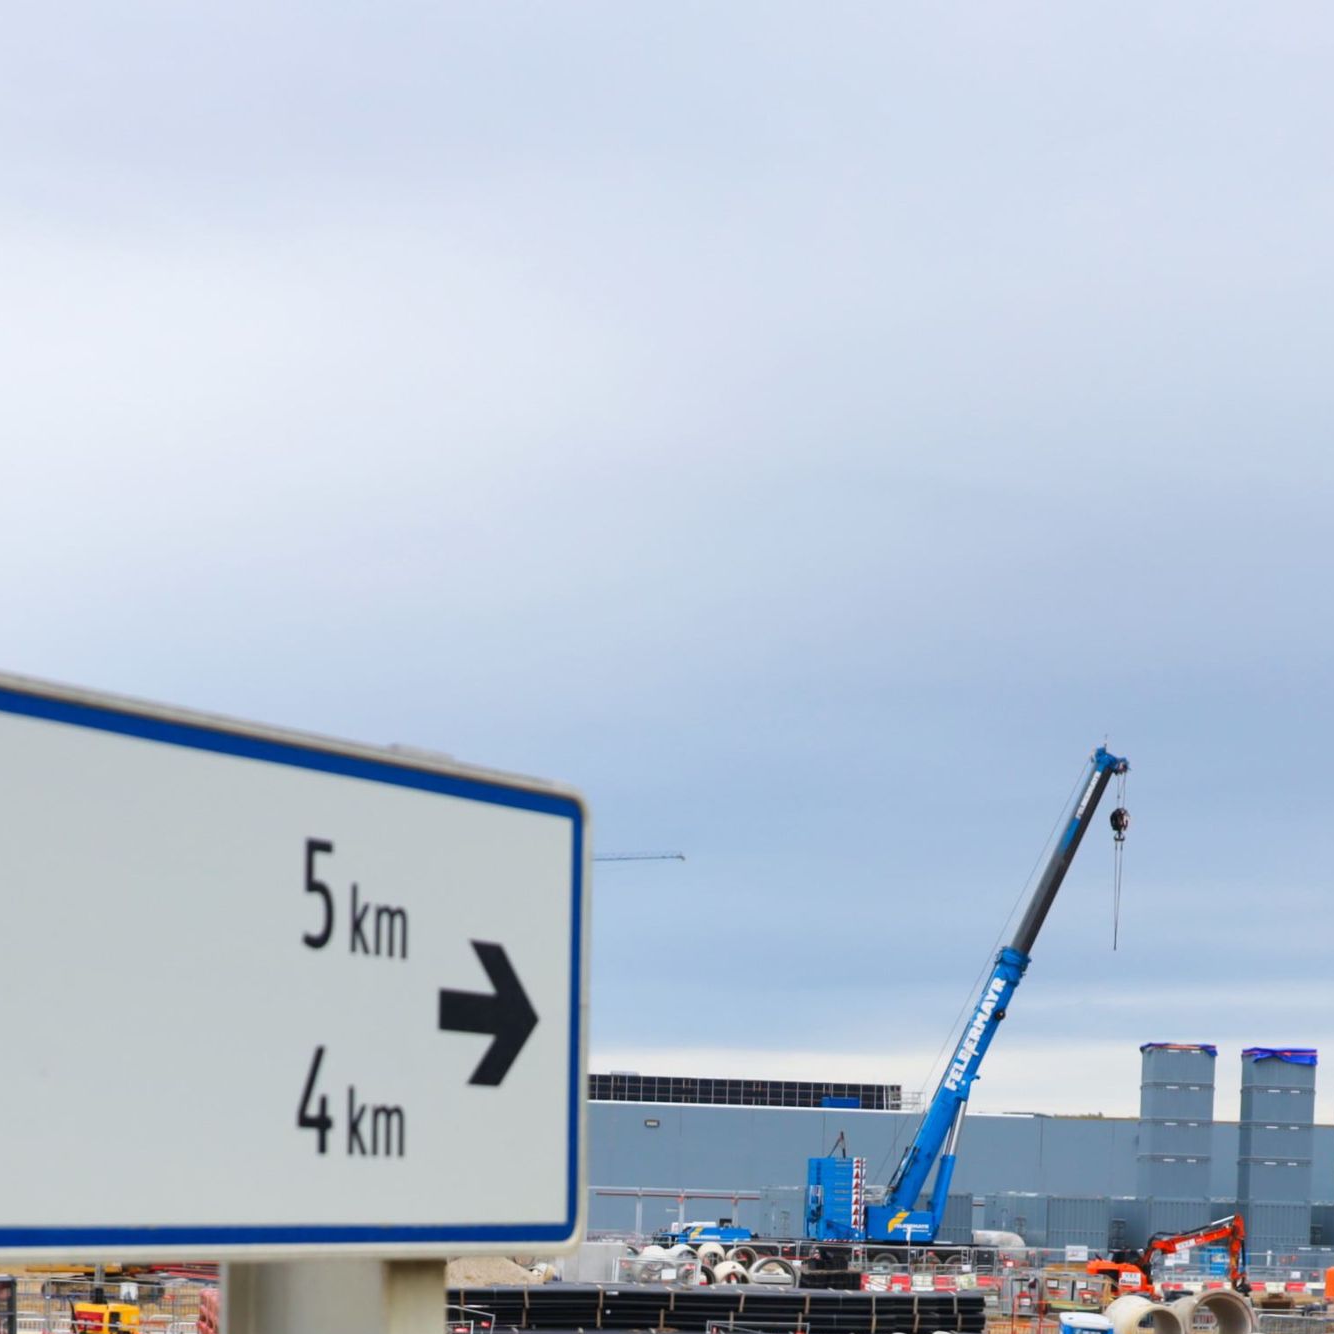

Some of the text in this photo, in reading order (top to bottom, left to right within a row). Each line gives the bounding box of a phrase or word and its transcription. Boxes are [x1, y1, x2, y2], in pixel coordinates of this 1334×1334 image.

[300, 836, 409, 961] 5 km
[295, 1044, 406, 1159] 4 km
